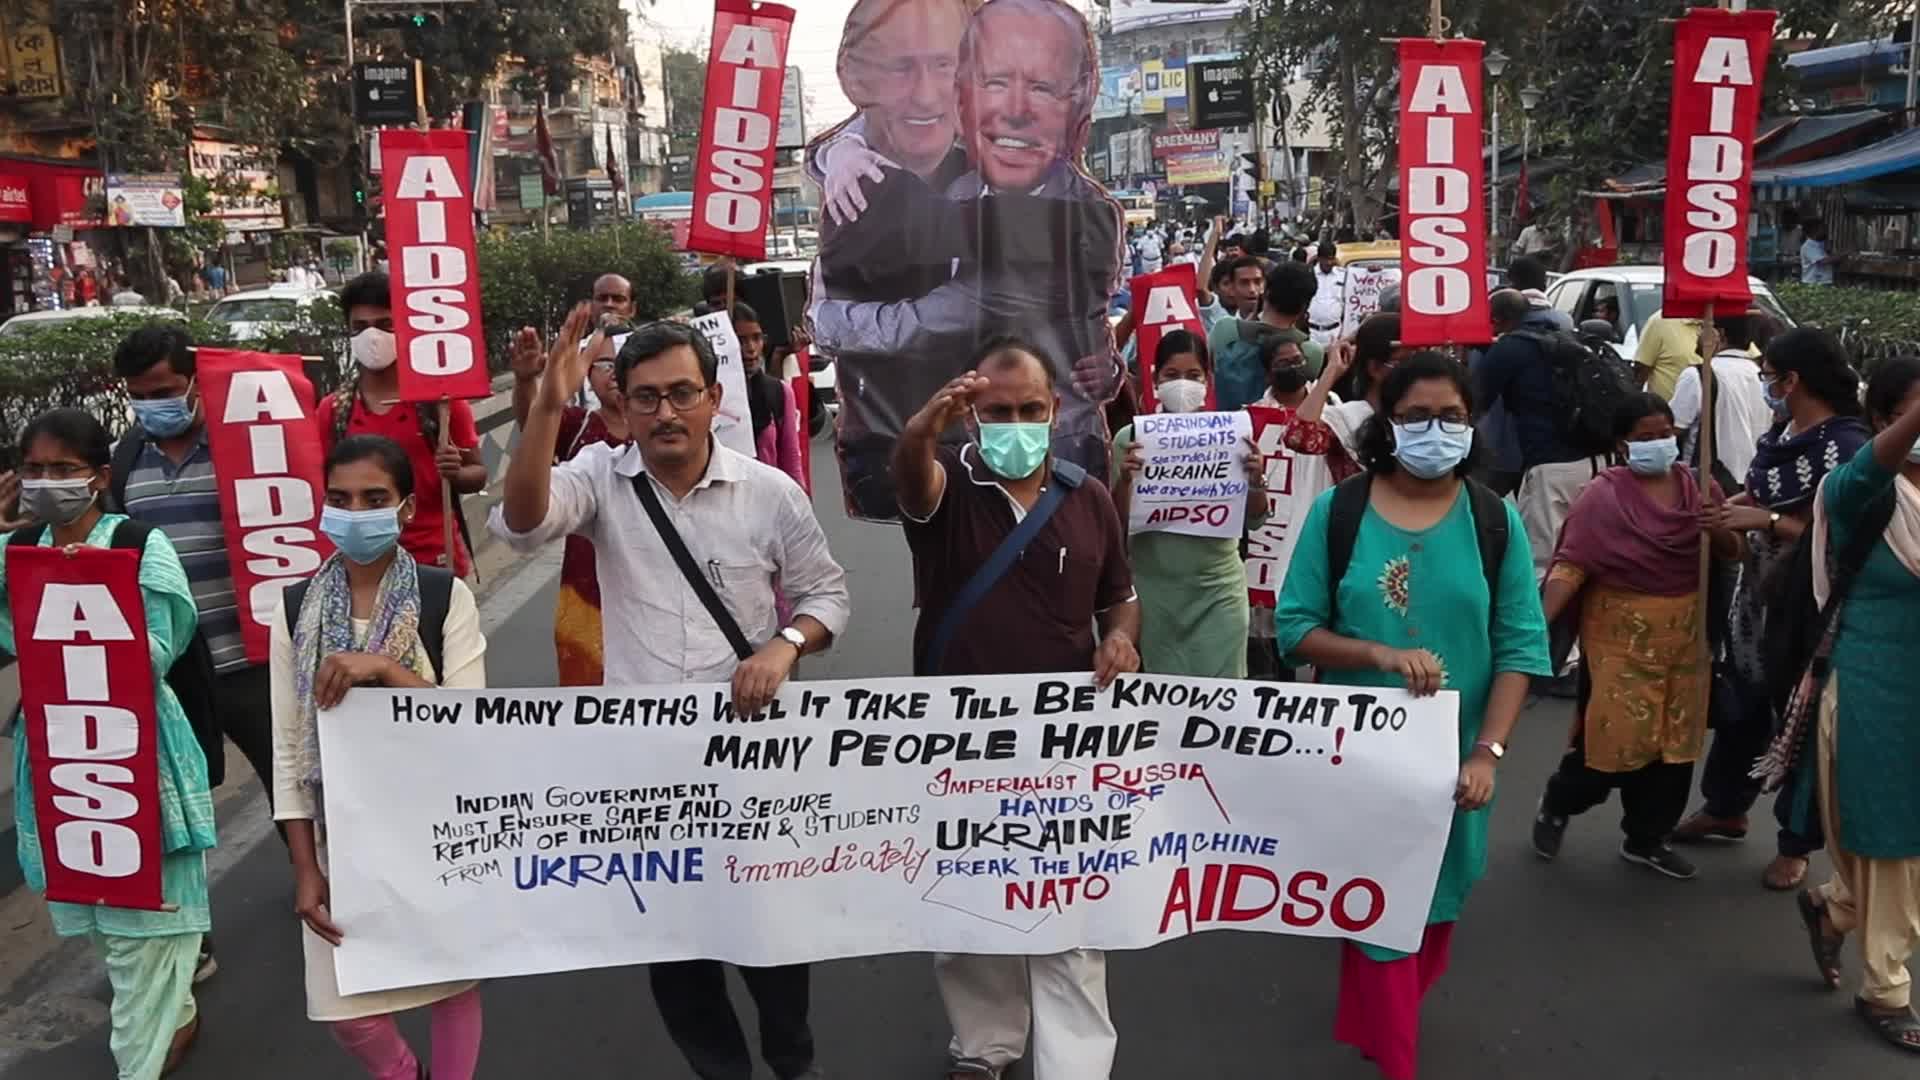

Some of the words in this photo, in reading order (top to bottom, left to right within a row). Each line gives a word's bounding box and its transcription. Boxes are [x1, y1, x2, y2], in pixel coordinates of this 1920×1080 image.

[364, 65, 407, 84] imagine
[1161, 72, 1183, 89] LIC
[705, 24, 780, 234] AIDSO
[1682, 36, 1753, 279] AIDSO
[1406, 64, 1474, 316] AIDSO
[396, 155, 476, 377] AIDSO
[1159, 431, 1236, 449] STUDENTS
[1145, 462, 1231, 481] UKRAINE
[1146, 504, 1229, 527] AIDSO
[391, 695, 462, 724] HOW
[475, 697, 563, 726] MANY
[574, 695, 698, 726] DEATHS
[800, 690, 830, 718] IT
[844, 689, 930, 720] TAKE
[950, 686, 1019, 719] TILL
[1034, 681, 1097, 715] BE
[1112, 678, 1237, 711] KNOWS
[1254, 687, 1340, 727] THAT
[1348, 694, 1407, 731] TOO
[33, 583, 142, 878] AIDSO
[703, 735, 813, 772] MANY
[829, 729, 1017, 767] PEOPLE
[1041, 720, 1159, 759] HAVE
[456, 792, 534, 819] INDIAN
[546, 783, 719, 808] GOVERNMENT
[926, 768, 1077, 797] IMPERIALIST
[1000, 794, 1093, 817] HANDS
[1108, 784, 1165, 809] OFF
[432, 820, 488, 841] MUST
[499, 813, 592, 834] ENSURE
[606, 804, 672, 827] SAFE
[678, 799, 732, 822] AND
[740, 793, 833, 820] SECURE
[432, 832, 525, 865] RETURN
[537, 832, 569, 850] OF
[580, 825, 661, 852] INDIAN
[671, 822, 770, 841] CITIZEN
[777, 816, 800, 849] &
[805, 804, 921, 837] STUDENTS
[937, 814, 1132, 854] UKRAINE
[437, 858, 503, 887] FROM
[514, 847, 704, 914] UKRAINE
[724, 837, 931, 884] immediately
[936, 858, 1018, 878] BREAK
[1030, 856, 1069, 875] THE
[1078, 849, 1140, 875] WAR
[1149, 832, 1278, 864] MACHINE
[1005, 875, 1110, 914] NATO
[1158, 863, 1385, 935] AIDSO
